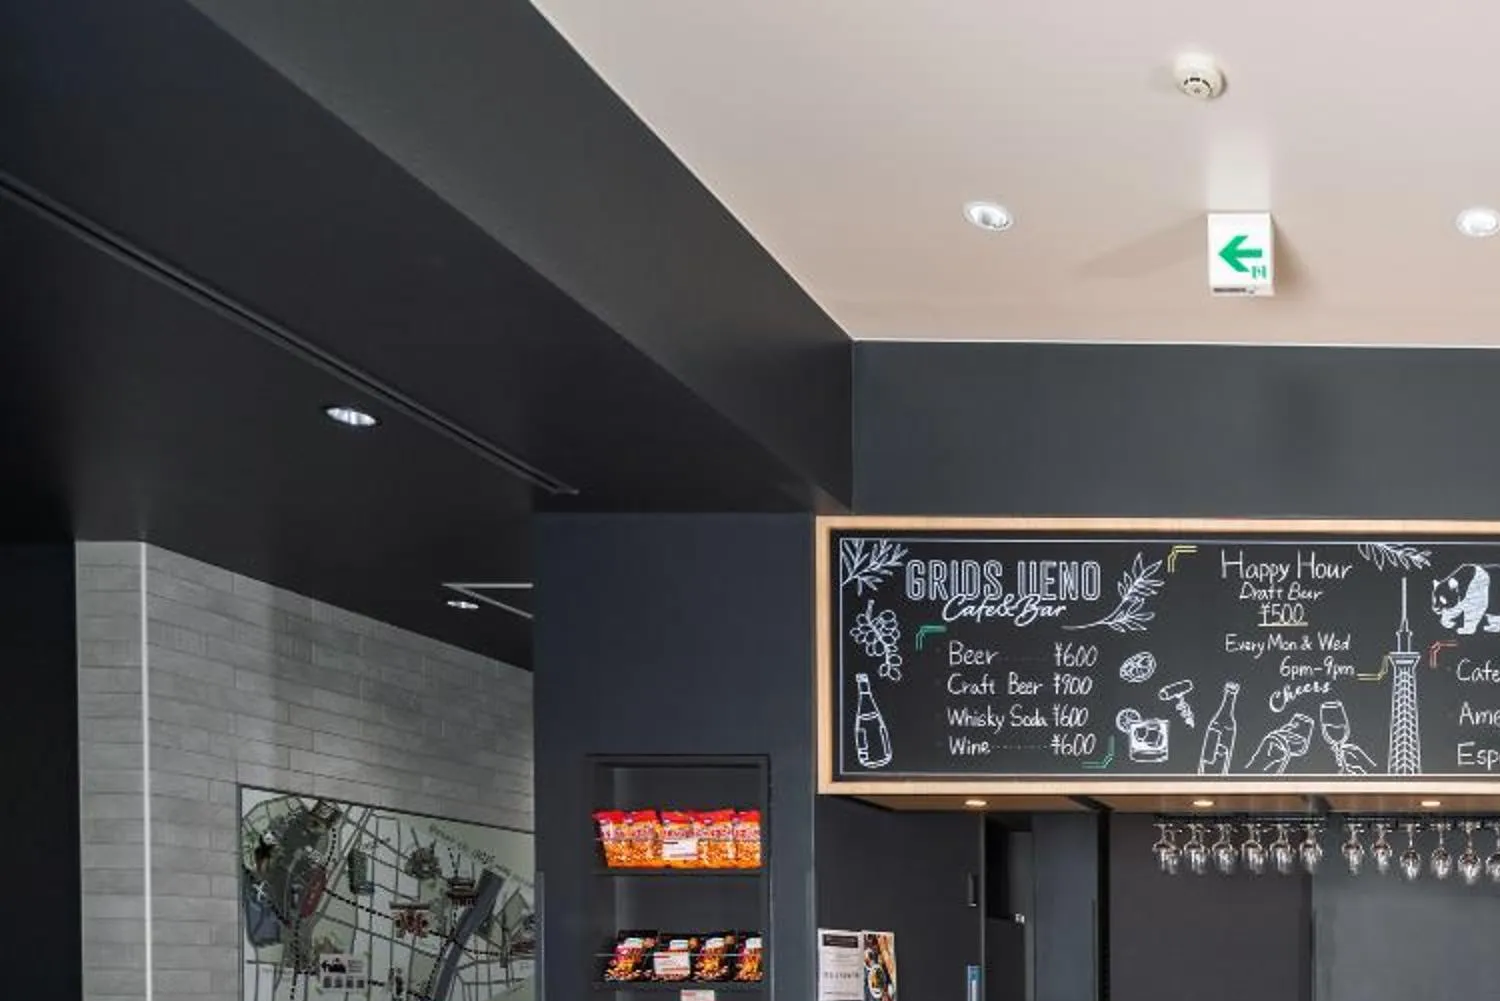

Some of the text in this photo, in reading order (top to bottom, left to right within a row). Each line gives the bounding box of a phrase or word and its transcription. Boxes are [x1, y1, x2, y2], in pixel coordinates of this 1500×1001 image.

[1221, 549, 1352, 583] Happy Hour
[905, 559, 1101, 600] GRIDS UENO
[1239, 580, 1323, 600] Draft Beer
[1258, 602, 1305, 626] ¥500
[949, 640, 1098, 667] Beer ¥600
[1225, 631, 1351, 659] Every Mon & Wed
[947, 671, 1093, 695] Craft Beer ¥900
[1456, 657, 1500, 683] Cafe
[946, 703, 1089, 734] Whisky Soda ¥600
[949, 733, 1097, 756] Wine ¥600
